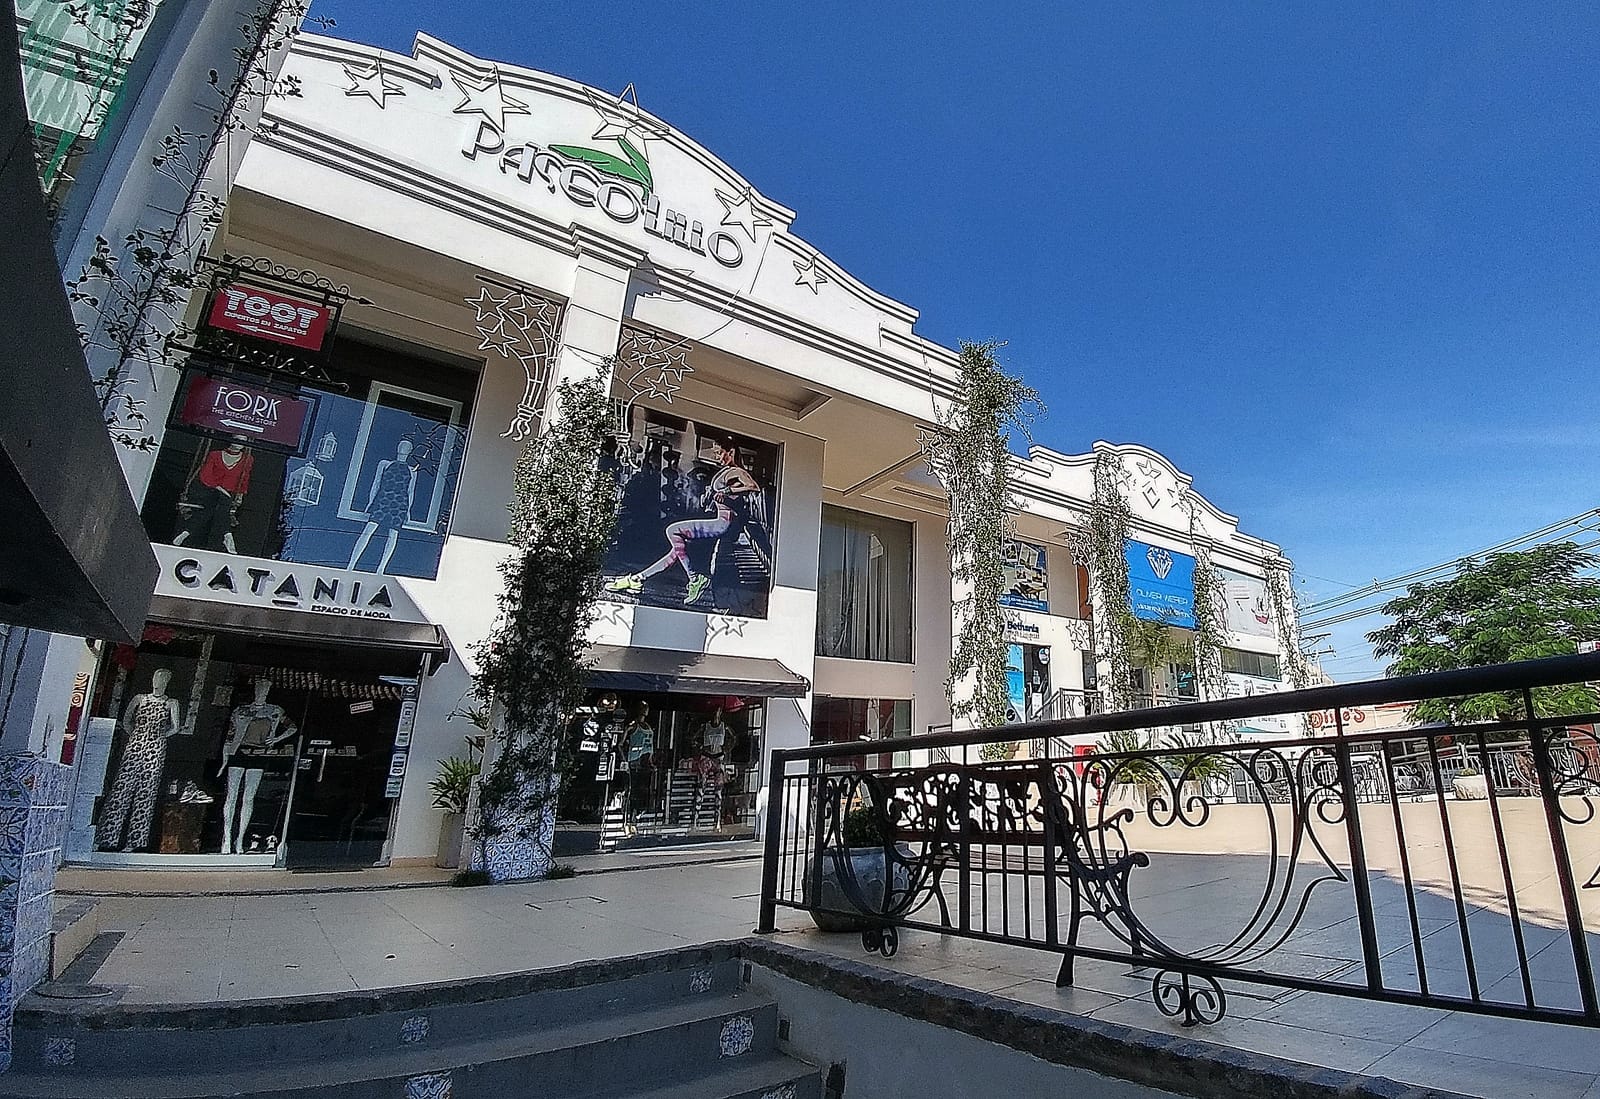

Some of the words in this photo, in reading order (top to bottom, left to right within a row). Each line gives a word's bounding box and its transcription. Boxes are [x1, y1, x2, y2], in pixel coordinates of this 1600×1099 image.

[462, 121, 642, 223] PASEO
[225, 289, 319, 329] TOOT
[273, 323, 307, 336] ZAPATOS
[211, 407, 224, 415] THE
[226, 411, 255, 422] KITCHEN
[214, 386, 281, 420] FORK
[175, 558, 392, 607] CATANIA
[311, 605, 348, 615] ESPACIO
[364, 610, 391, 619] MODA
